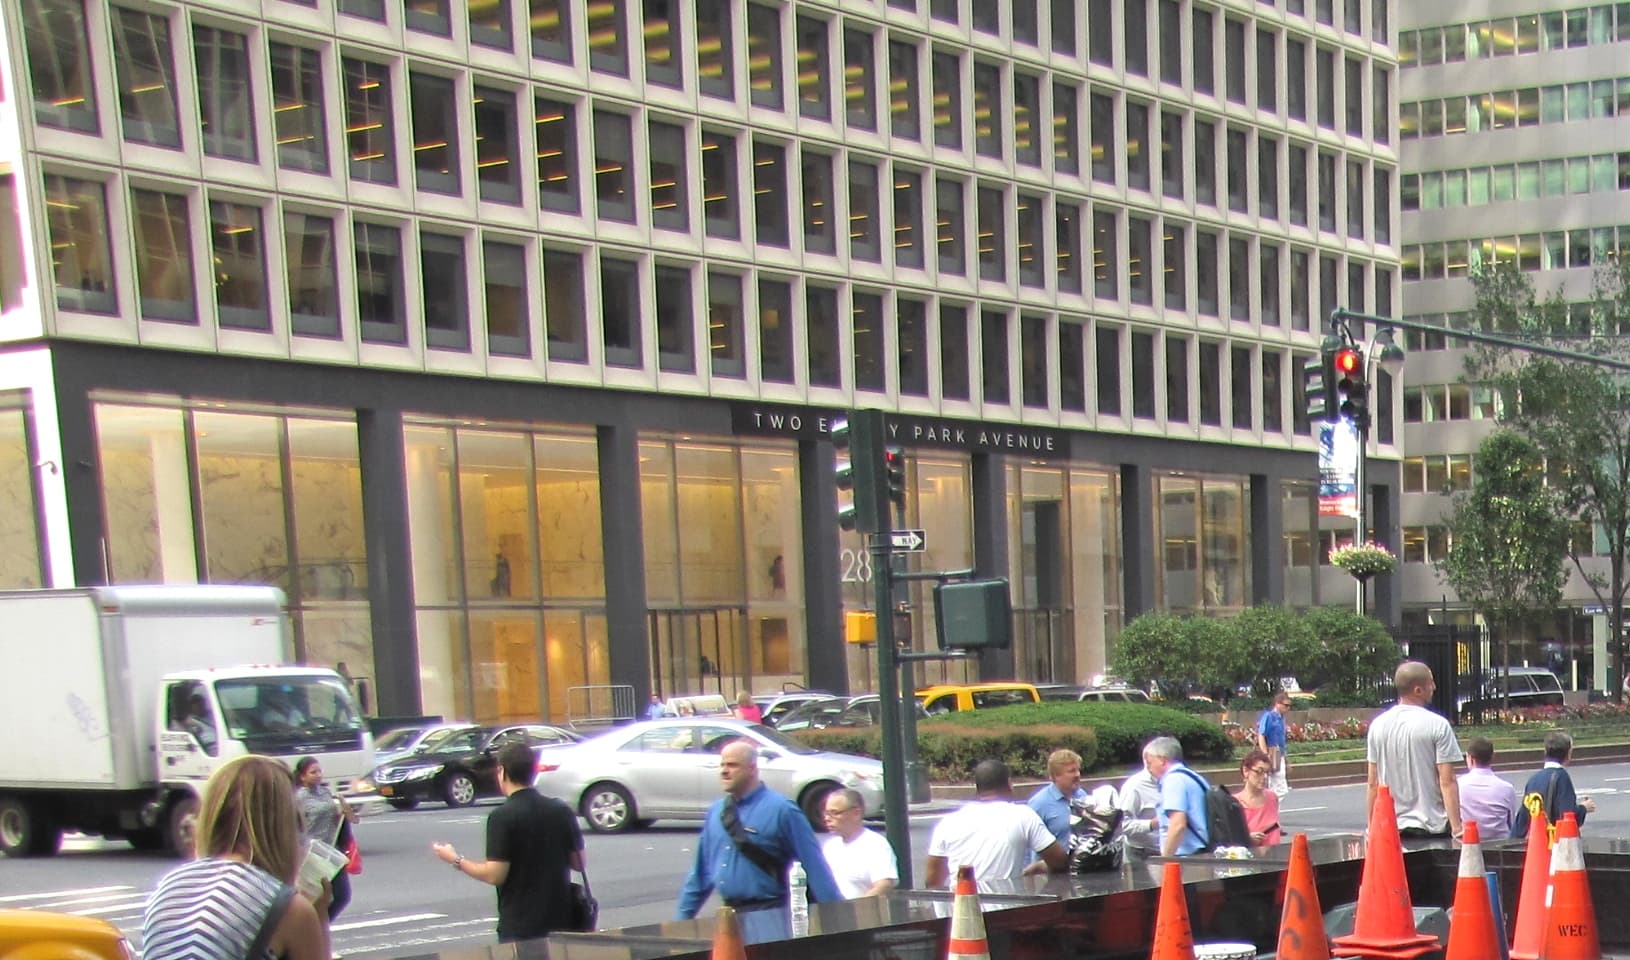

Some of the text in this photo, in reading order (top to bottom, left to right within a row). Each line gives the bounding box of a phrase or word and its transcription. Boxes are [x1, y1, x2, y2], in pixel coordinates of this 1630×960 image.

[754, 413, 802, 431] TWO
[914, 425, 965, 443] PARK
[979, 431, 1054, 451] AVENUE
